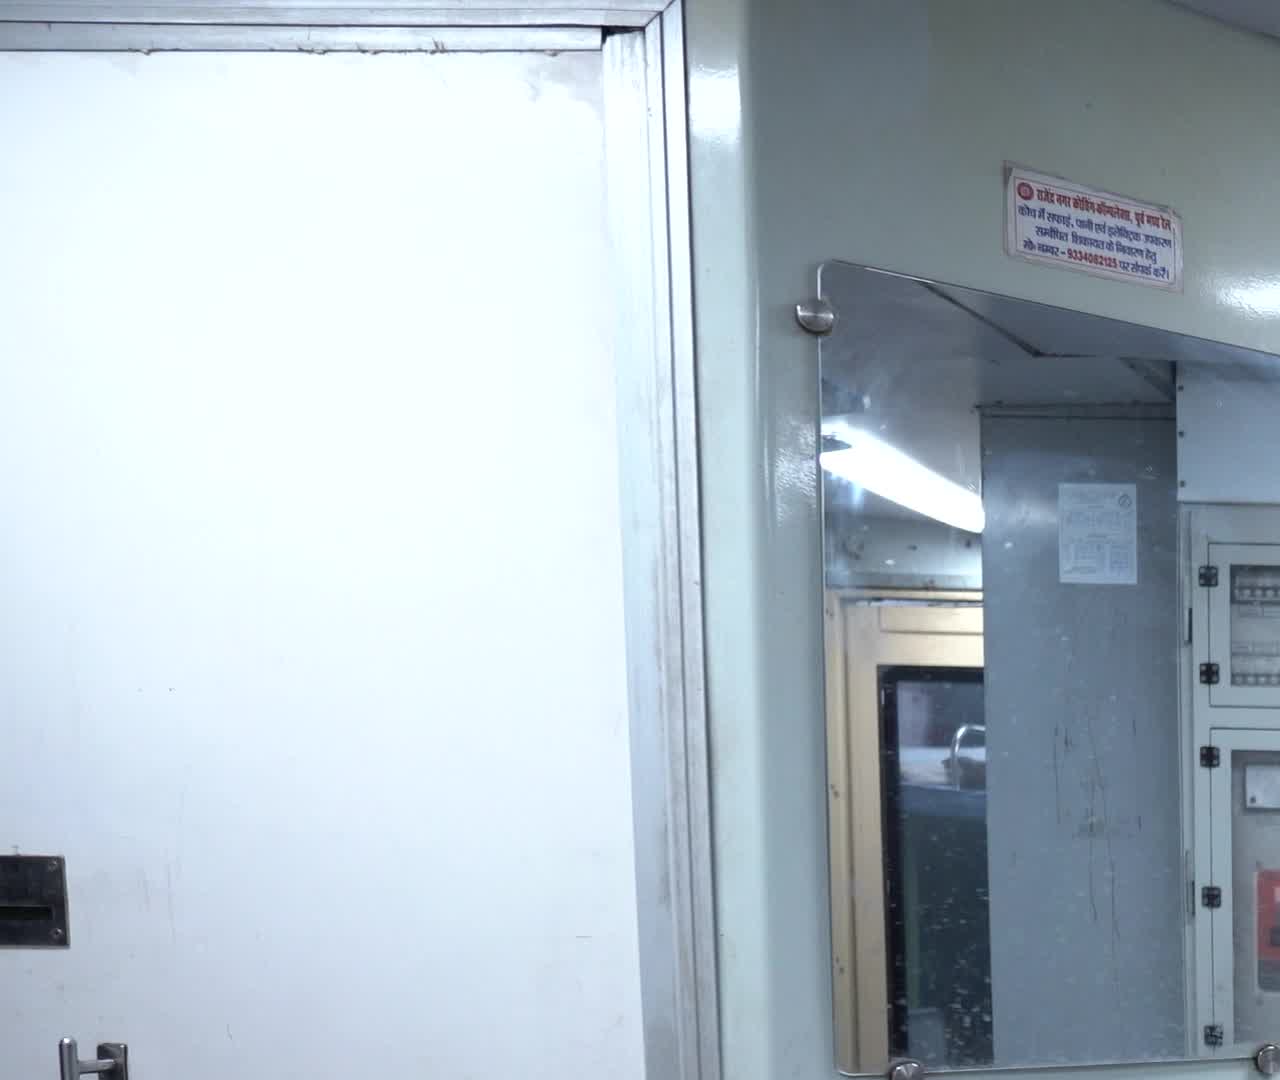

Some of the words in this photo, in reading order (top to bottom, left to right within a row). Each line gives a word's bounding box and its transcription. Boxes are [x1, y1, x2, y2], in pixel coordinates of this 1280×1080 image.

[1056, 194, 1071, 207] नगर
[1018, 204, 1036, 218] कोच
[1075, 217, 1093, 231] पानी
[1095, 222, 1105, 234] एवं
[1106, 239, 1114, 251] के
[1116, 241, 1144, 258] निवारण
[1145, 248, 1157, 264] हेतु
[1119, 261, 1130, 272] पर
